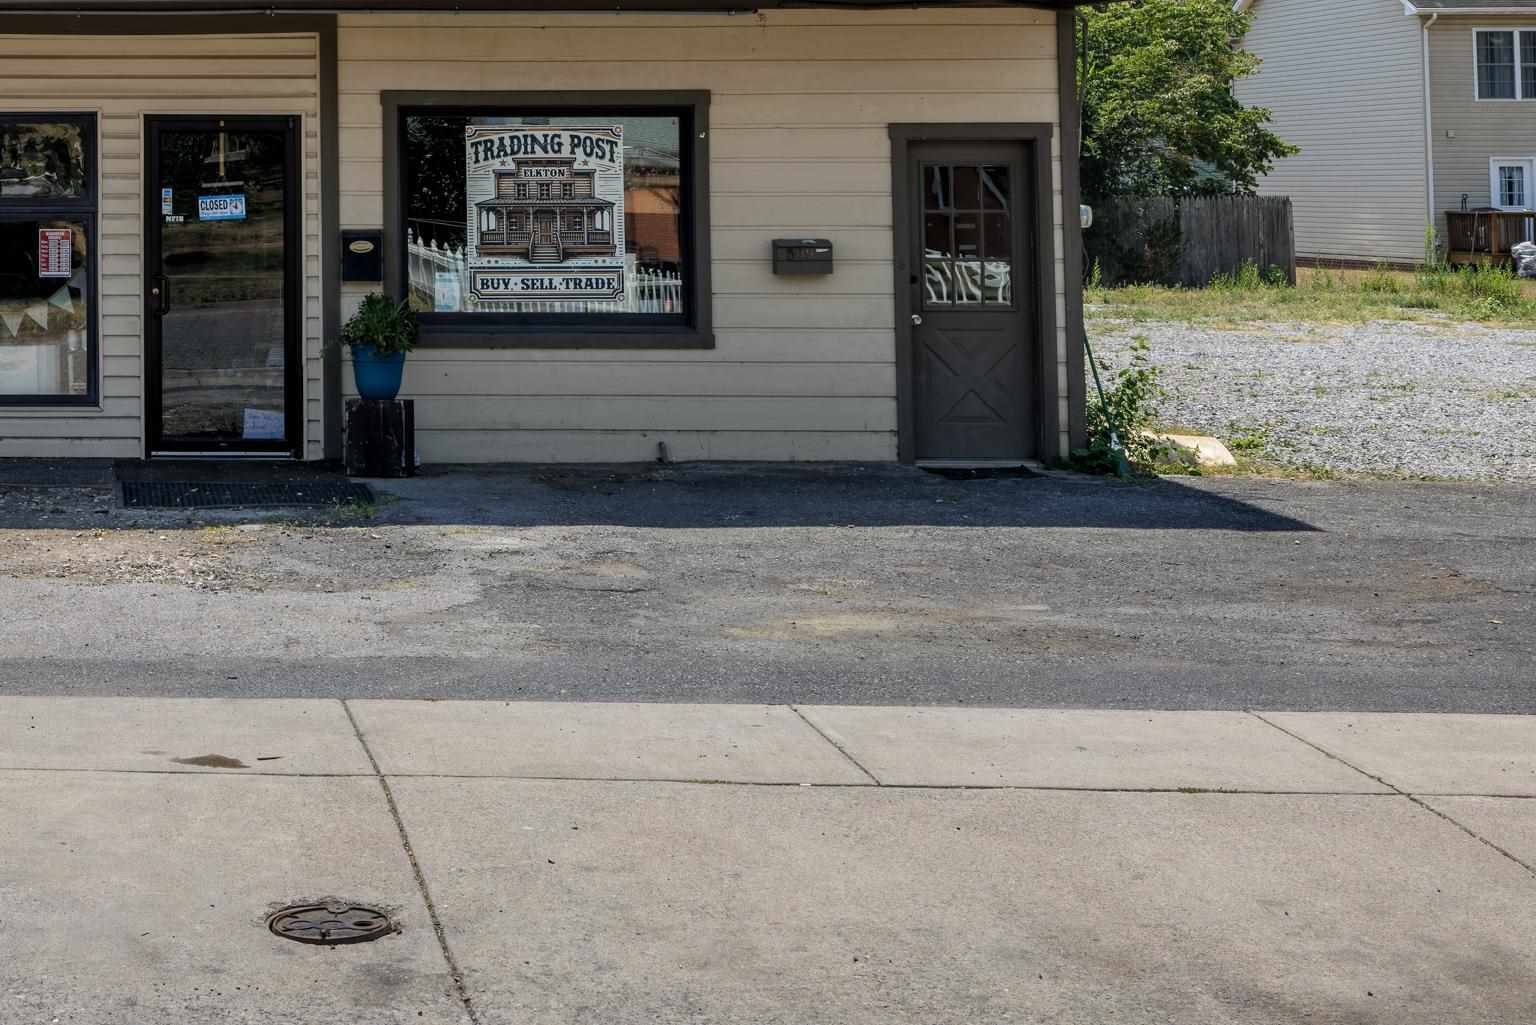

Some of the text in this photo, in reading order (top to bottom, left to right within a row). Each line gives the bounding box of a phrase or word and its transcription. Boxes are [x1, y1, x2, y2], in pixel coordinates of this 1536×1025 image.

[470, 133, 619, 165] TRADING POST
[523, 168, 565, 177] ELKTON
[200, 199, 228, 211] CLOSED
[479, 277, 615, 290] BUY SELL TRADE
